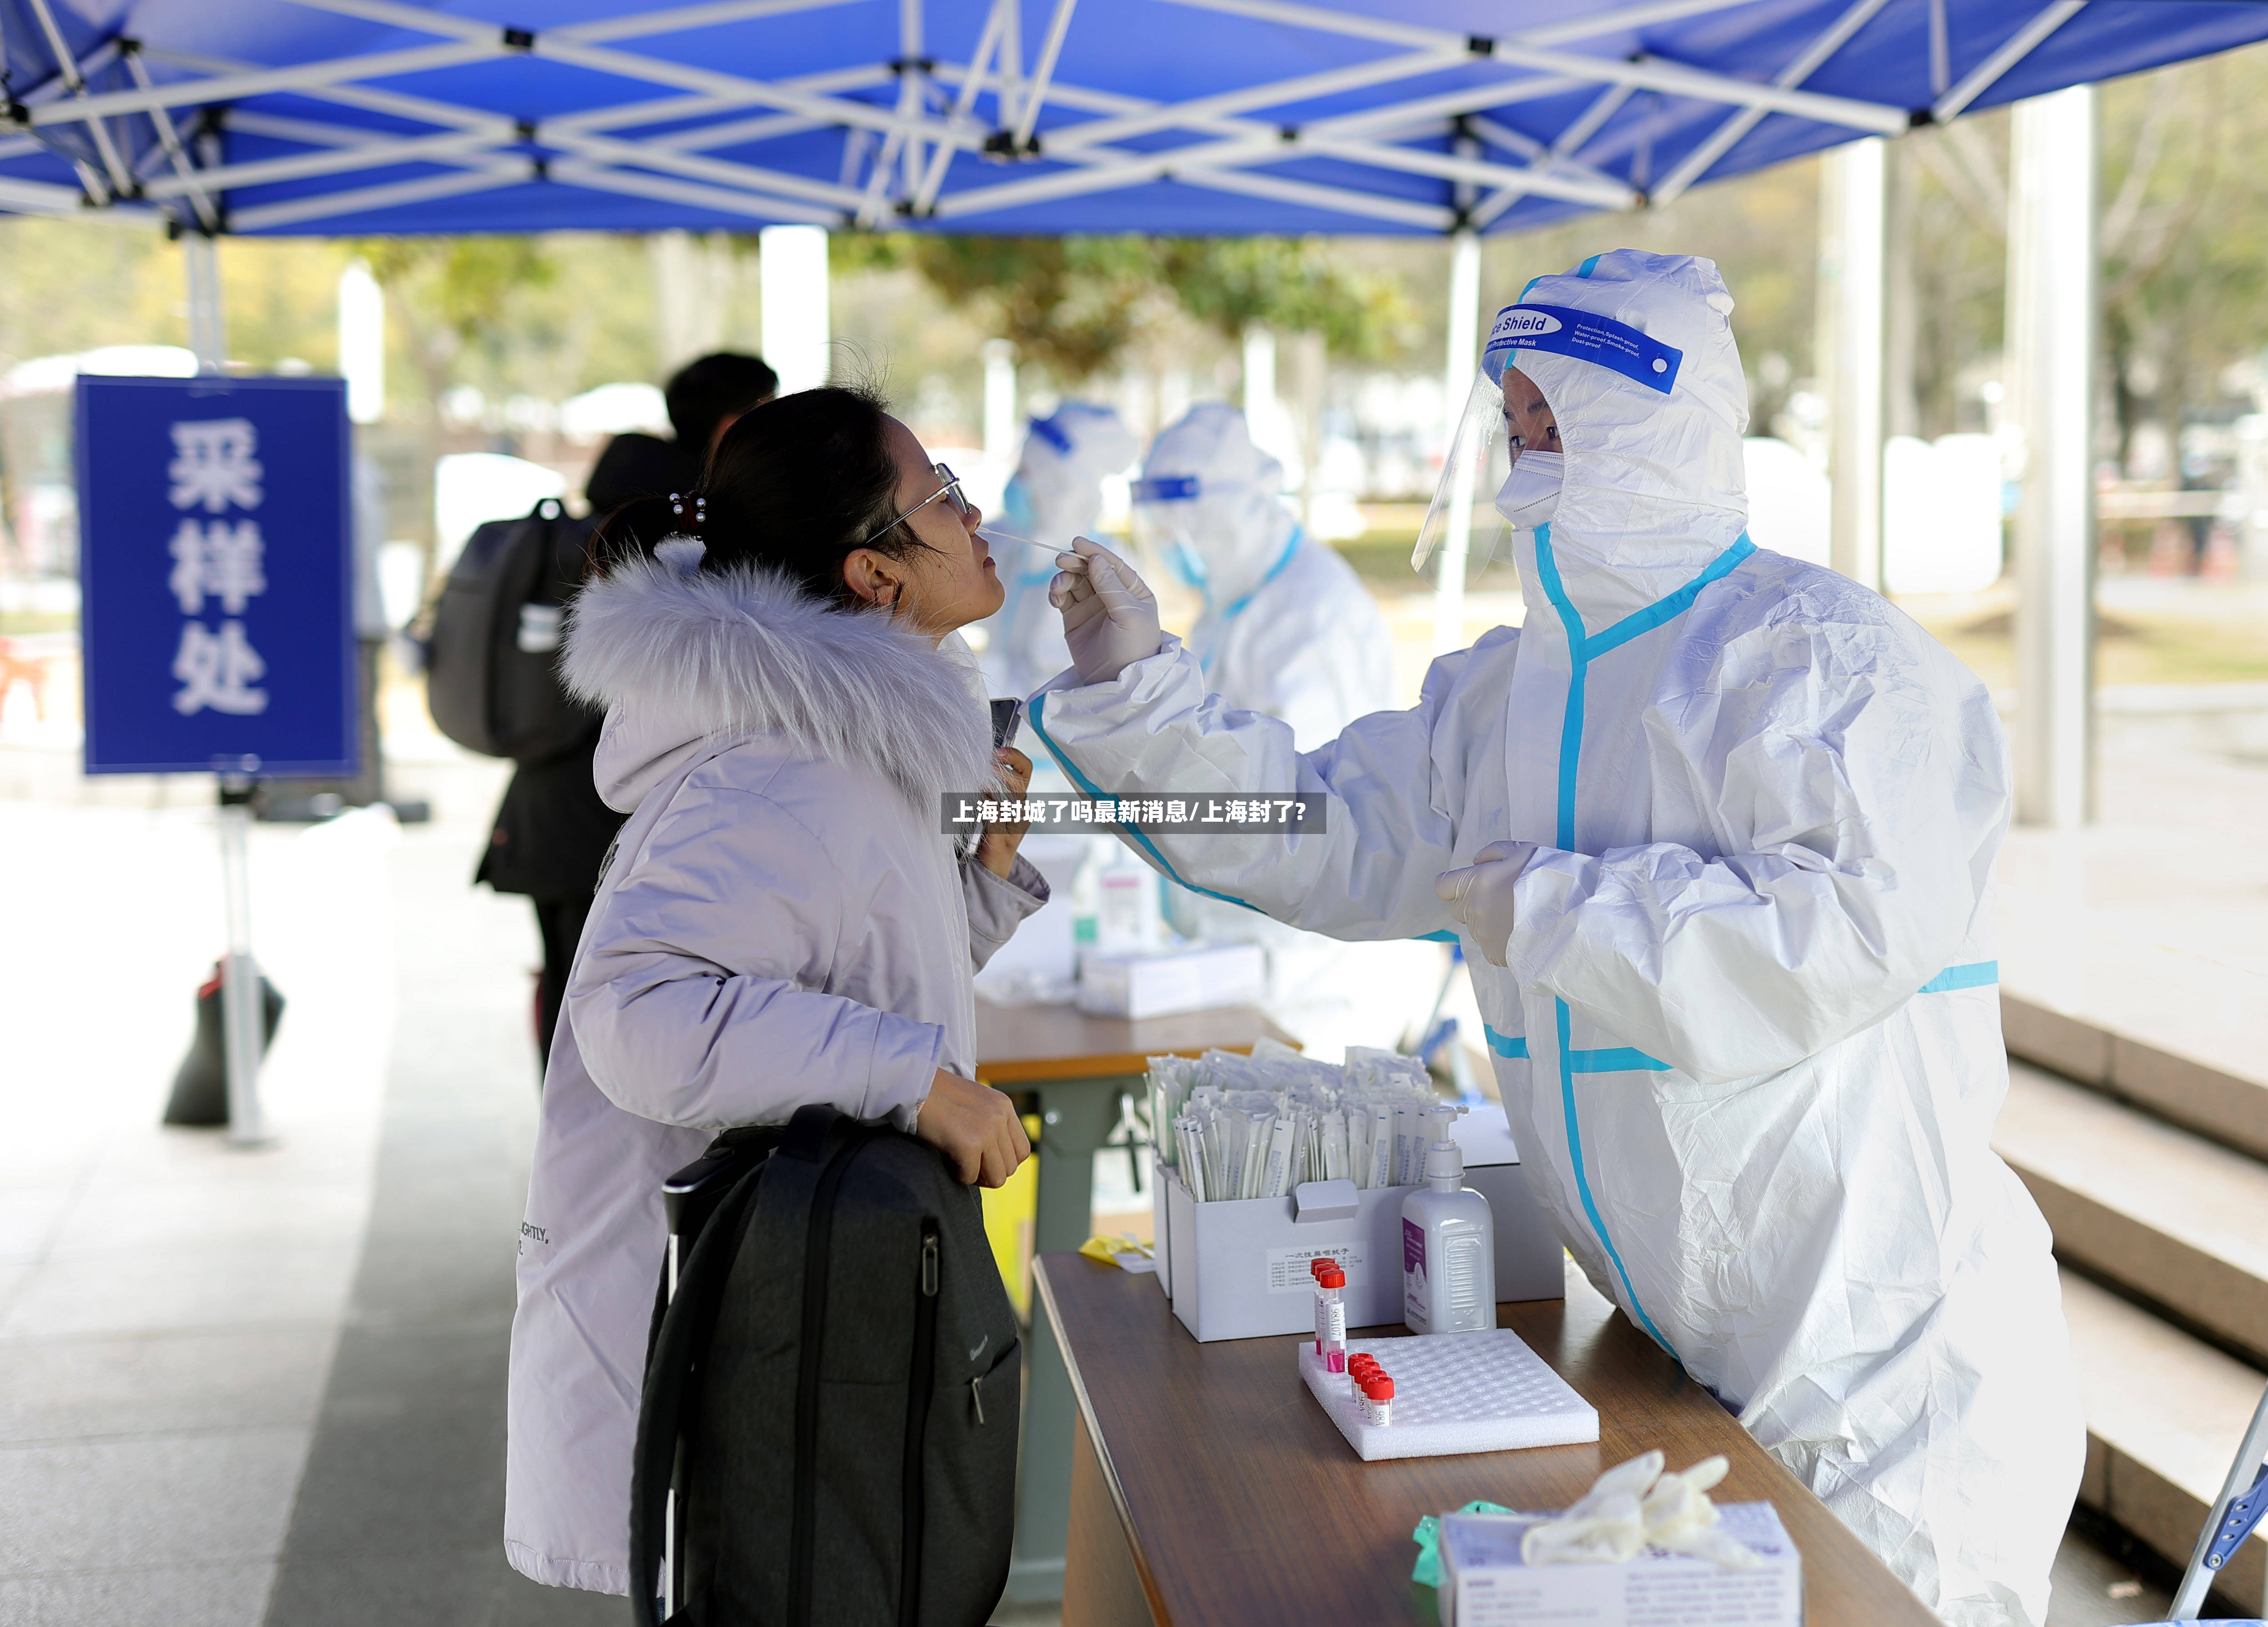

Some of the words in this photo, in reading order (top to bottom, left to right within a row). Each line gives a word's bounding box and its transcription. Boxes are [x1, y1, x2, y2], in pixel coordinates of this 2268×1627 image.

[1503, 316, 1547, 331] Shield
[1492, 339, 1517, 348] Protective
[1572, 337, 1601, 349] Dust-proof
[168, 417, 268, 715] 采样处
[1331, 1309, 1341, 1336] 98A107
